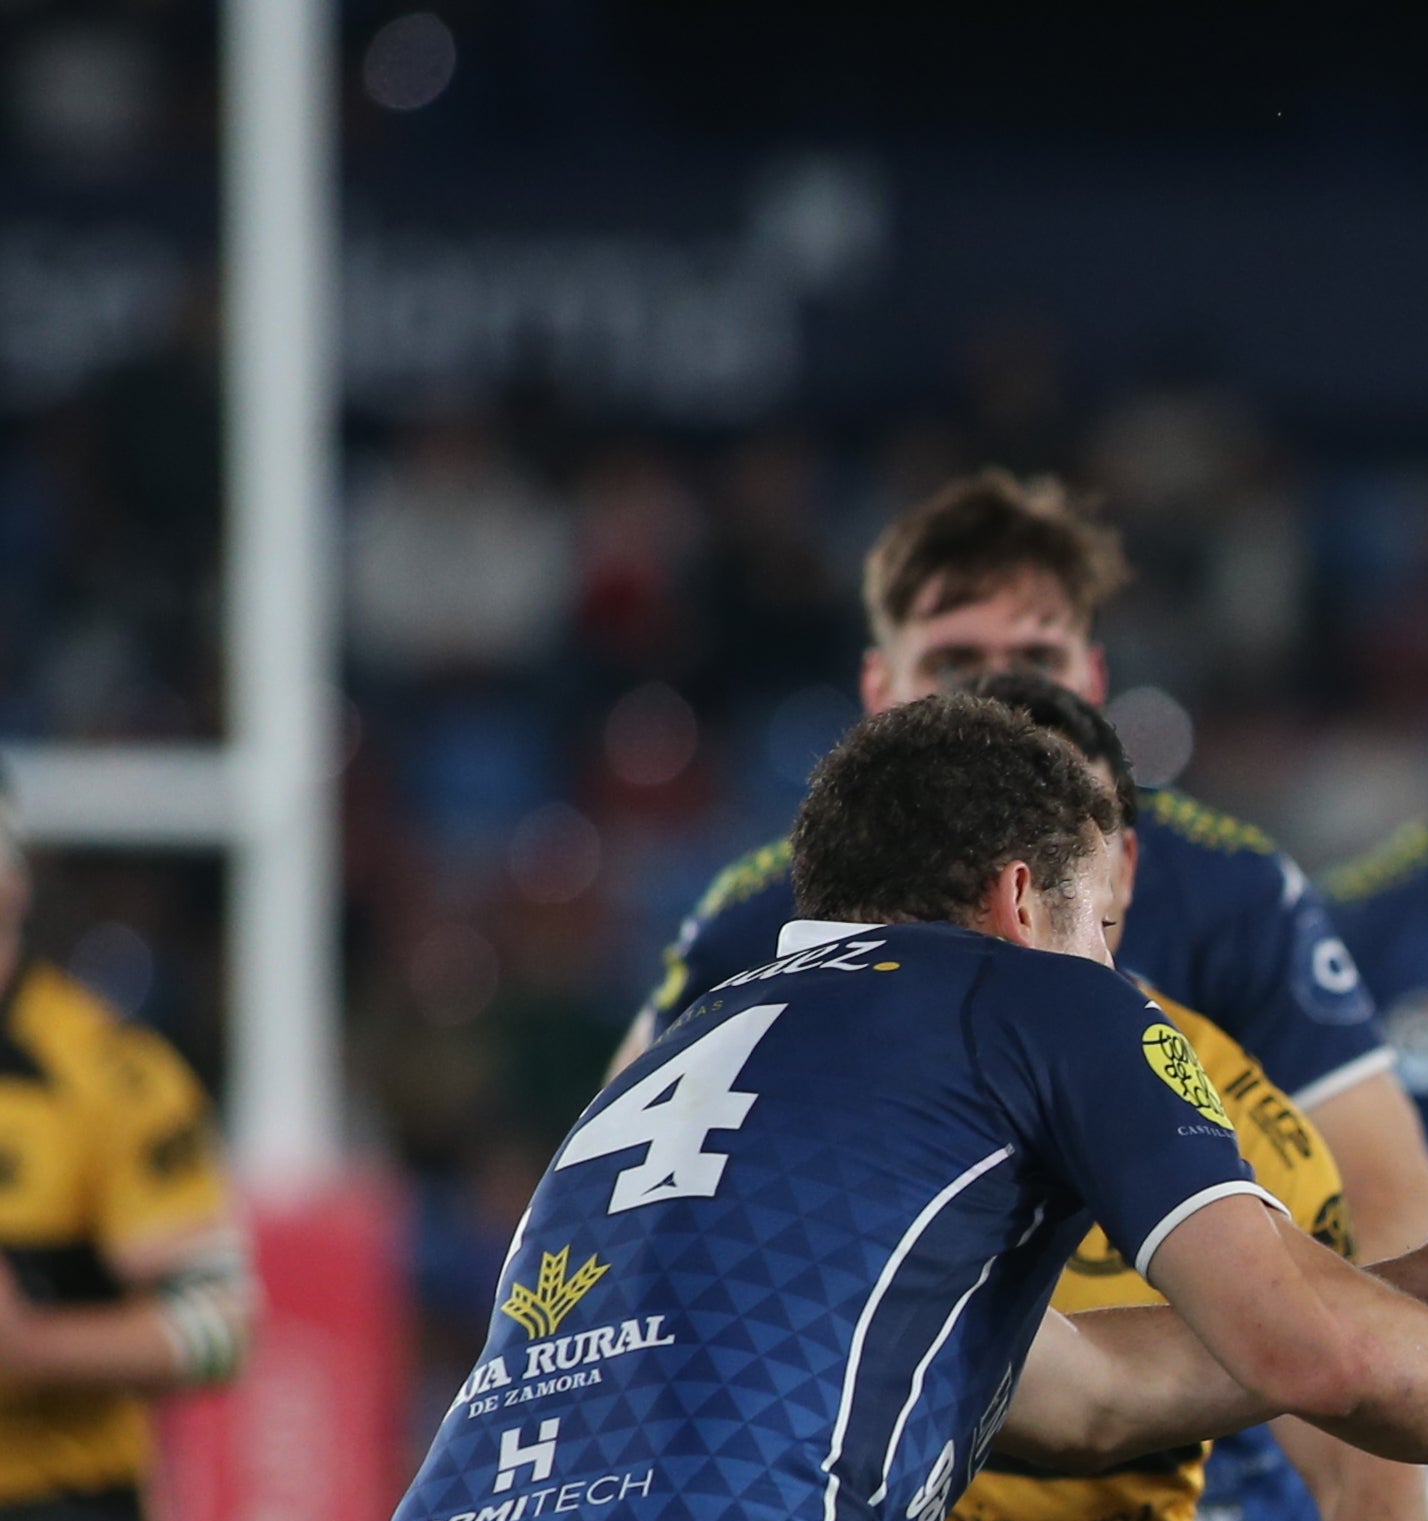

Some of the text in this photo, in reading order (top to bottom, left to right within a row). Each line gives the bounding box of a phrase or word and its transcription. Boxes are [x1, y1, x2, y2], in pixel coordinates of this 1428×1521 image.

[554, 1003, 788, 1215] 4
[523, 1314, 676, 1380] RURAL
[467, 1367, 602, 1420] DE ZAMORA
